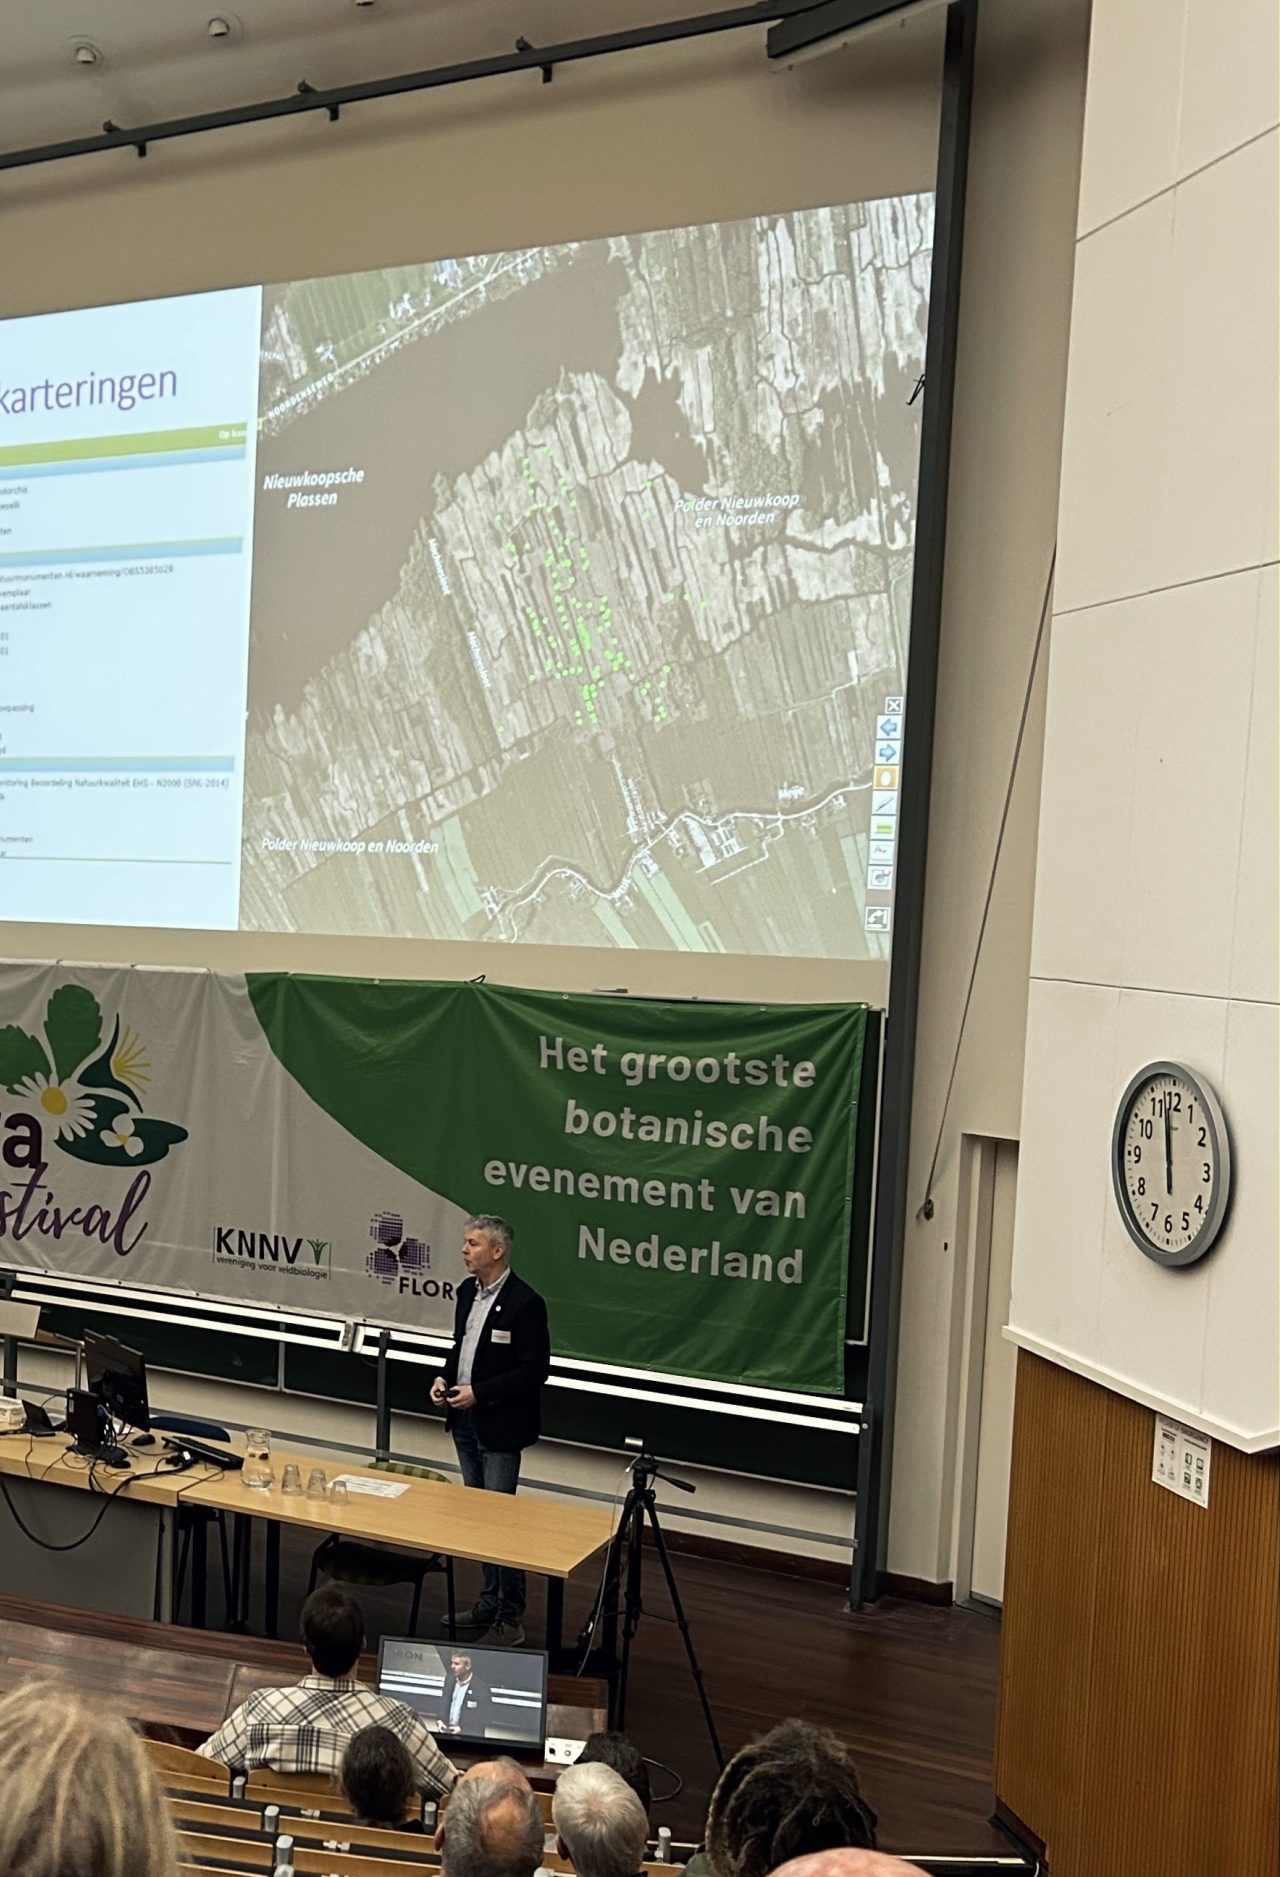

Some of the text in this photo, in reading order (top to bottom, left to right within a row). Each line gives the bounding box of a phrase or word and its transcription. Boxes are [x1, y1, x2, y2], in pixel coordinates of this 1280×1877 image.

[263, 467, 365, 490] Nieuwkoopsche
[287, 491, 338, 508] Plassen
[674, 492, 800, 513] Polder Nieuwkoop
[695, 510, 775, 528] en Noorden
[30, 778, 73, 788] Beoordeling
[74, 778, 131, 787] Natuurkwaliteit
[132, 778, 149, 788] EHS
[261, 838, 439, 855] Polder Nieuwkoop en Noorden
[539, 1036, 817, 1088] Het grootste
[1150, 1097, 1163, 1118] 11
[1167, 1091, 1182, 1113] 12
[1187, 1104, 1193, 1124] 1
[564, 1099, 813, 1153] botanische
[1139, 1118, 1153, 1140] 10
[1197, 1127, 1206, 1147] 2
[1133, 1145, 1141, 1164] 9
[1202, 1163, 1210, 1183] 3
[483, 1158, 806, 1220] evenement van
[1137, 1176, 1146, 1196] 8
[1151, 1202, 1159, 1222] 7
[1194, 1194, 1203, 1214] 4
[1164, 1214, 1172, 1234] 6
[1181, 1211, 1190, 1231] 5
[216, 1226, 304, 1265] KNNV
[577, 1224, 804, 1285] Nederland
[216, 1255, 328, 1280] vereniging voor veldbiologie
[399, 1276, 455, 1301] FLOR
